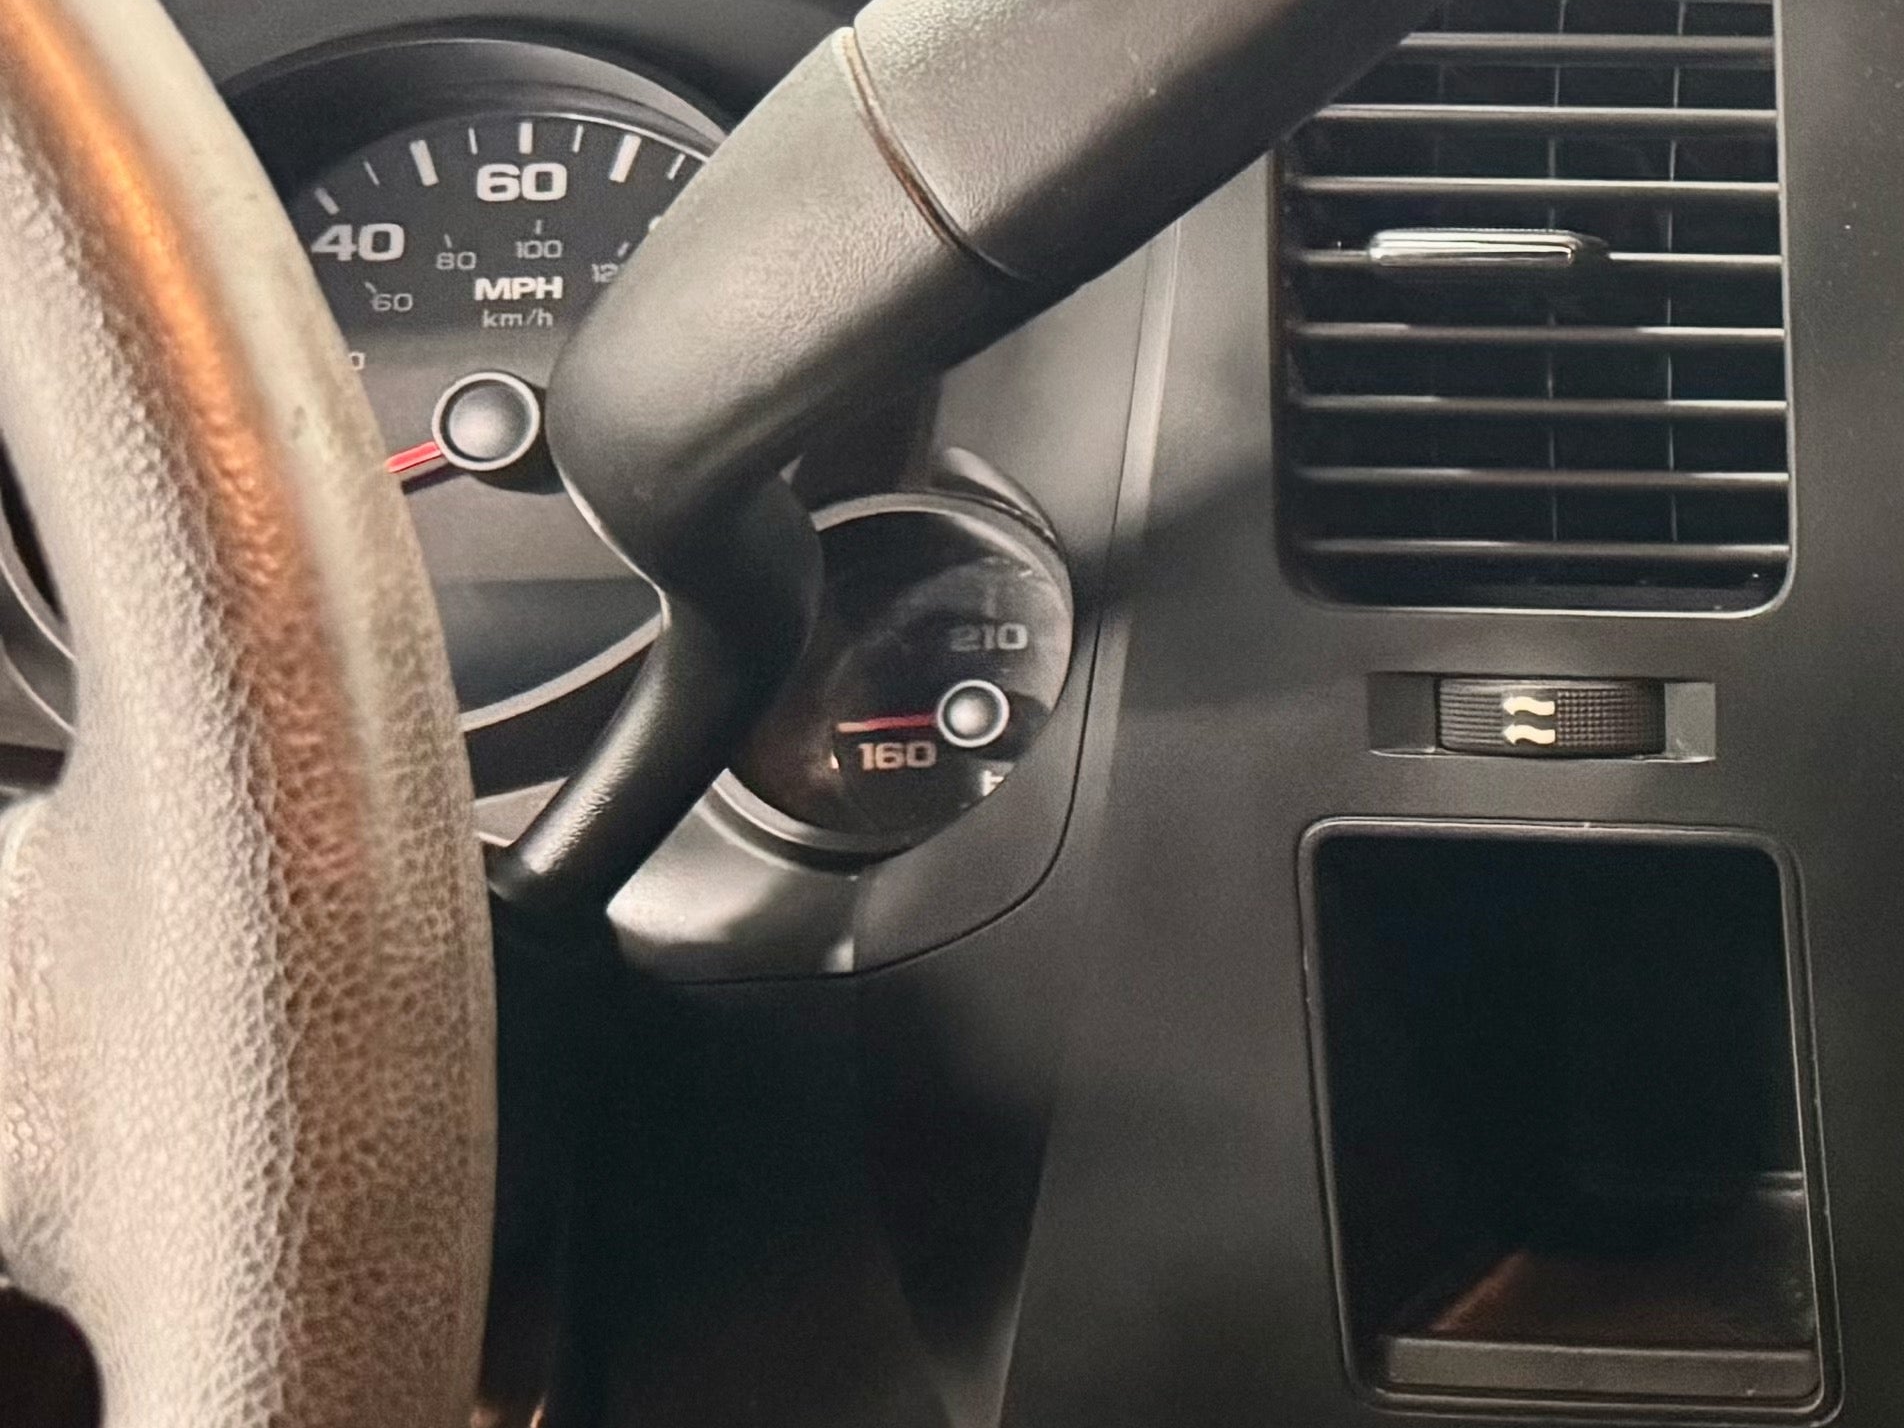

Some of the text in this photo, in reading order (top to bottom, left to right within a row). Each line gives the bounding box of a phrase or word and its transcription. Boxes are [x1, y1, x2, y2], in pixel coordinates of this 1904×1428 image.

[475, 162, 568, 202] 60
[311, 223, 405, 262] 40
[515, 239, 563, 259] 100
[435, 251, 477, 271] 80
[474, 276, 563, 301] MPH
[371, 293, 414, 312] 60
[483, 309, 554, 328] km/h
[950, 622, 1028, 652] 210
[857, 740, 937, 770] 160
